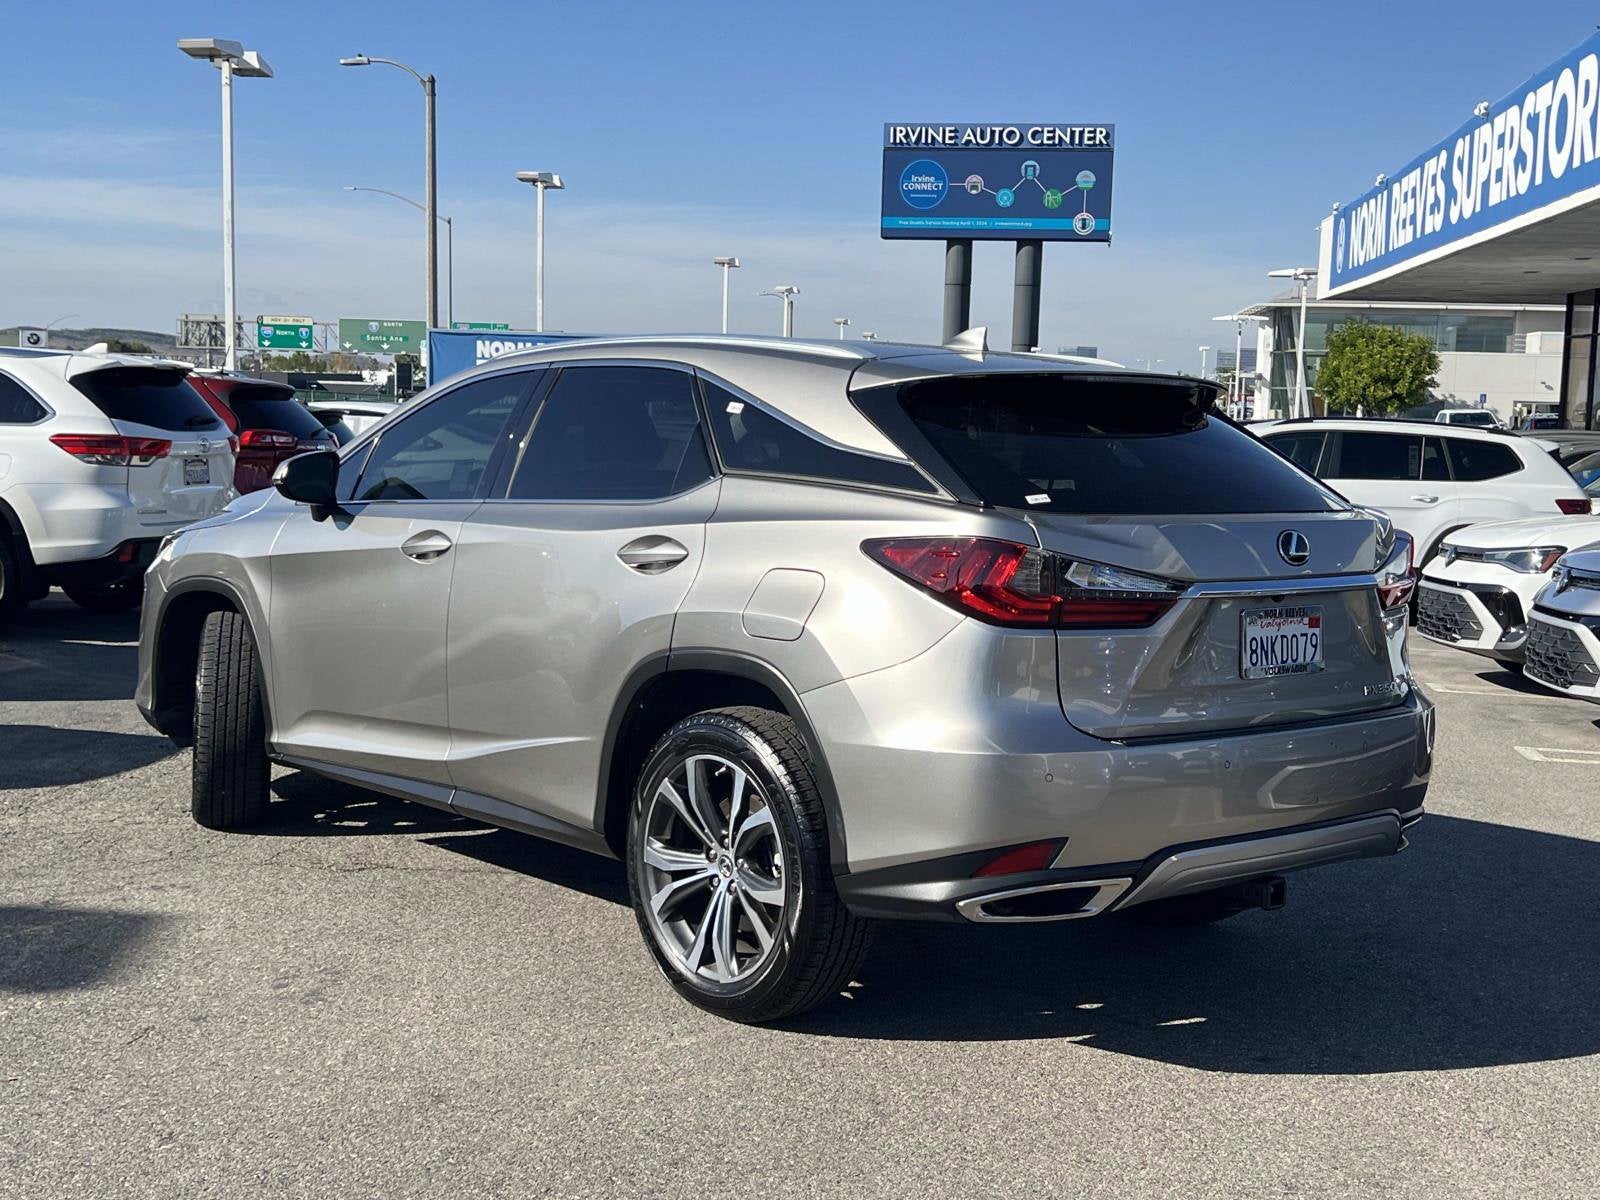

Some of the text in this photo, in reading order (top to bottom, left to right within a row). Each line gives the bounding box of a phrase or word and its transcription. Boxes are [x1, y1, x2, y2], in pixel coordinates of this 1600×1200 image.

[889, 126, 1107, 145] IRVINE AUTO CENTER
[911, 174, 935, 182] Irvine
[903, 182, 943, 191] CONNECT
[1349, 190, 1387, 269] NORM
[1389, 150, 1447, 251] REEVES
[366, 334, 387, 342] Santa
[1249, 632, 1319, 667] 8NKD079
